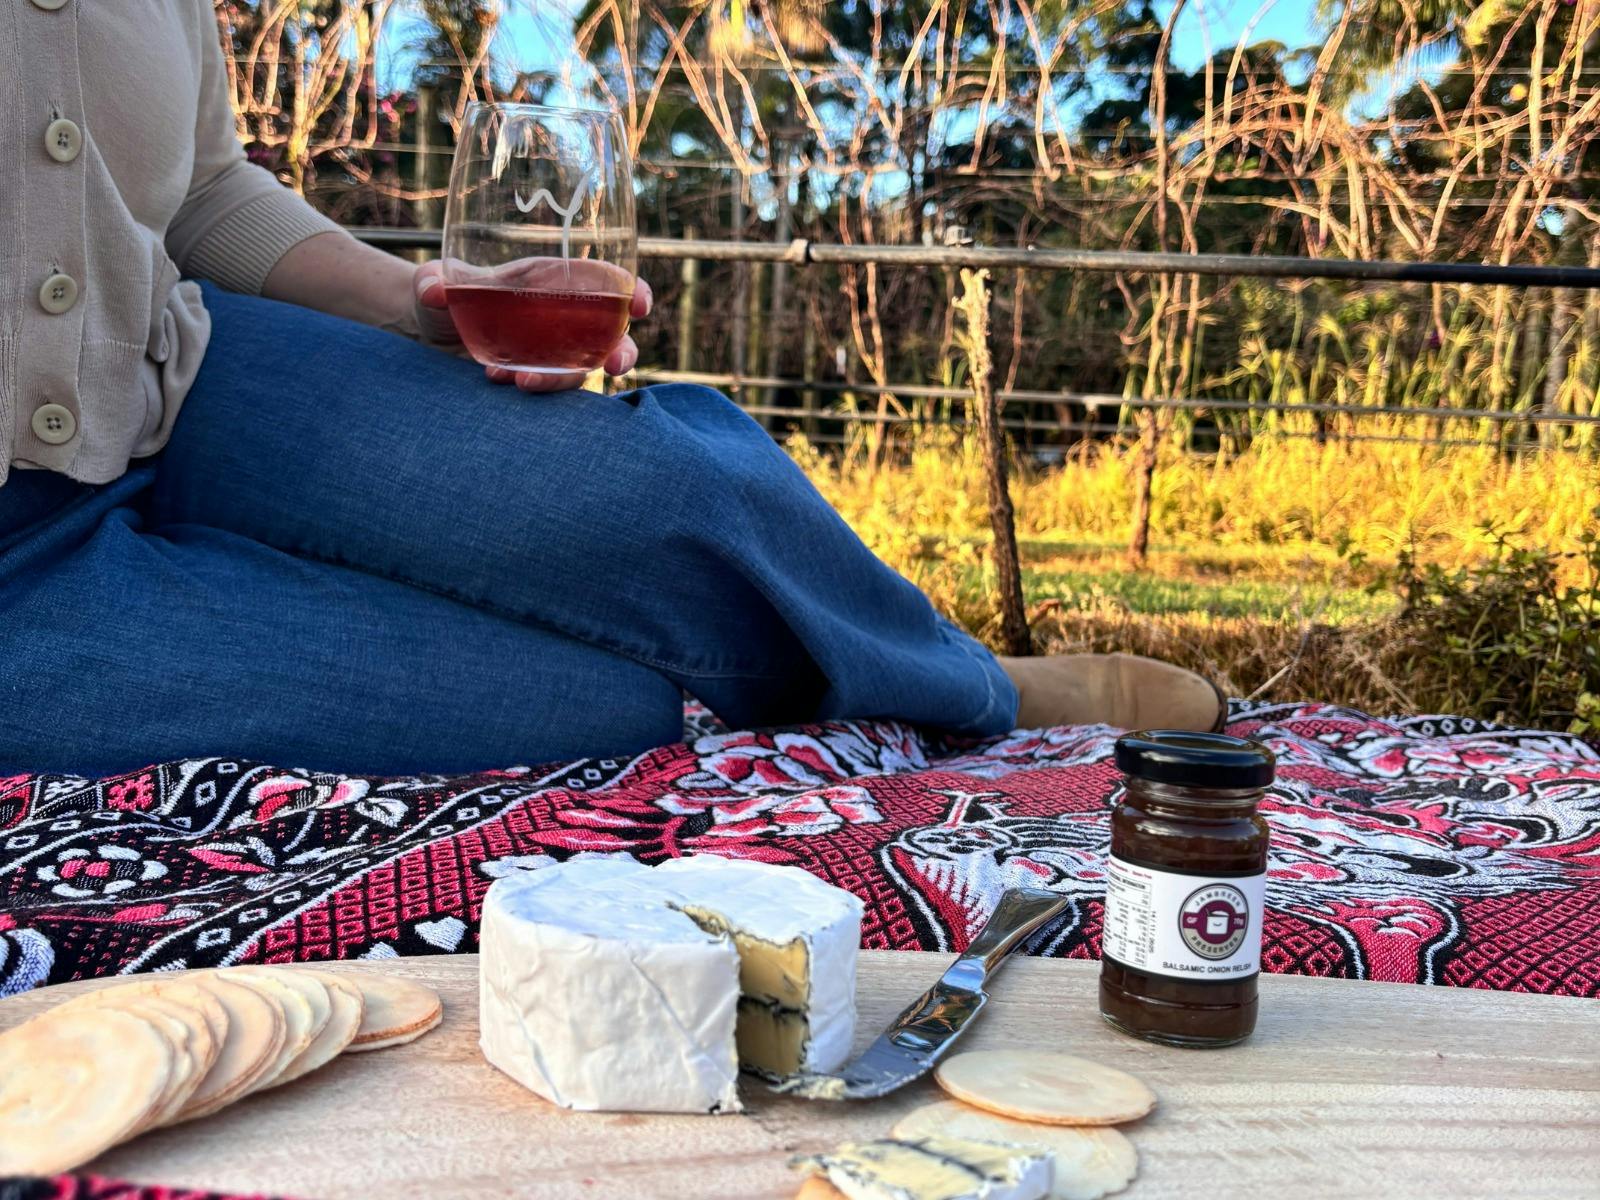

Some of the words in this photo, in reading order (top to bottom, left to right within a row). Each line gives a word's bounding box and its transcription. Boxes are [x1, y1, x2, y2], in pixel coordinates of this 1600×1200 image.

[1191, 936, 1238, 953] PRESERVES
[1162, 961, 1205, 973] BALSAMIC
[1232, 963, 1252, 972] RELISH
